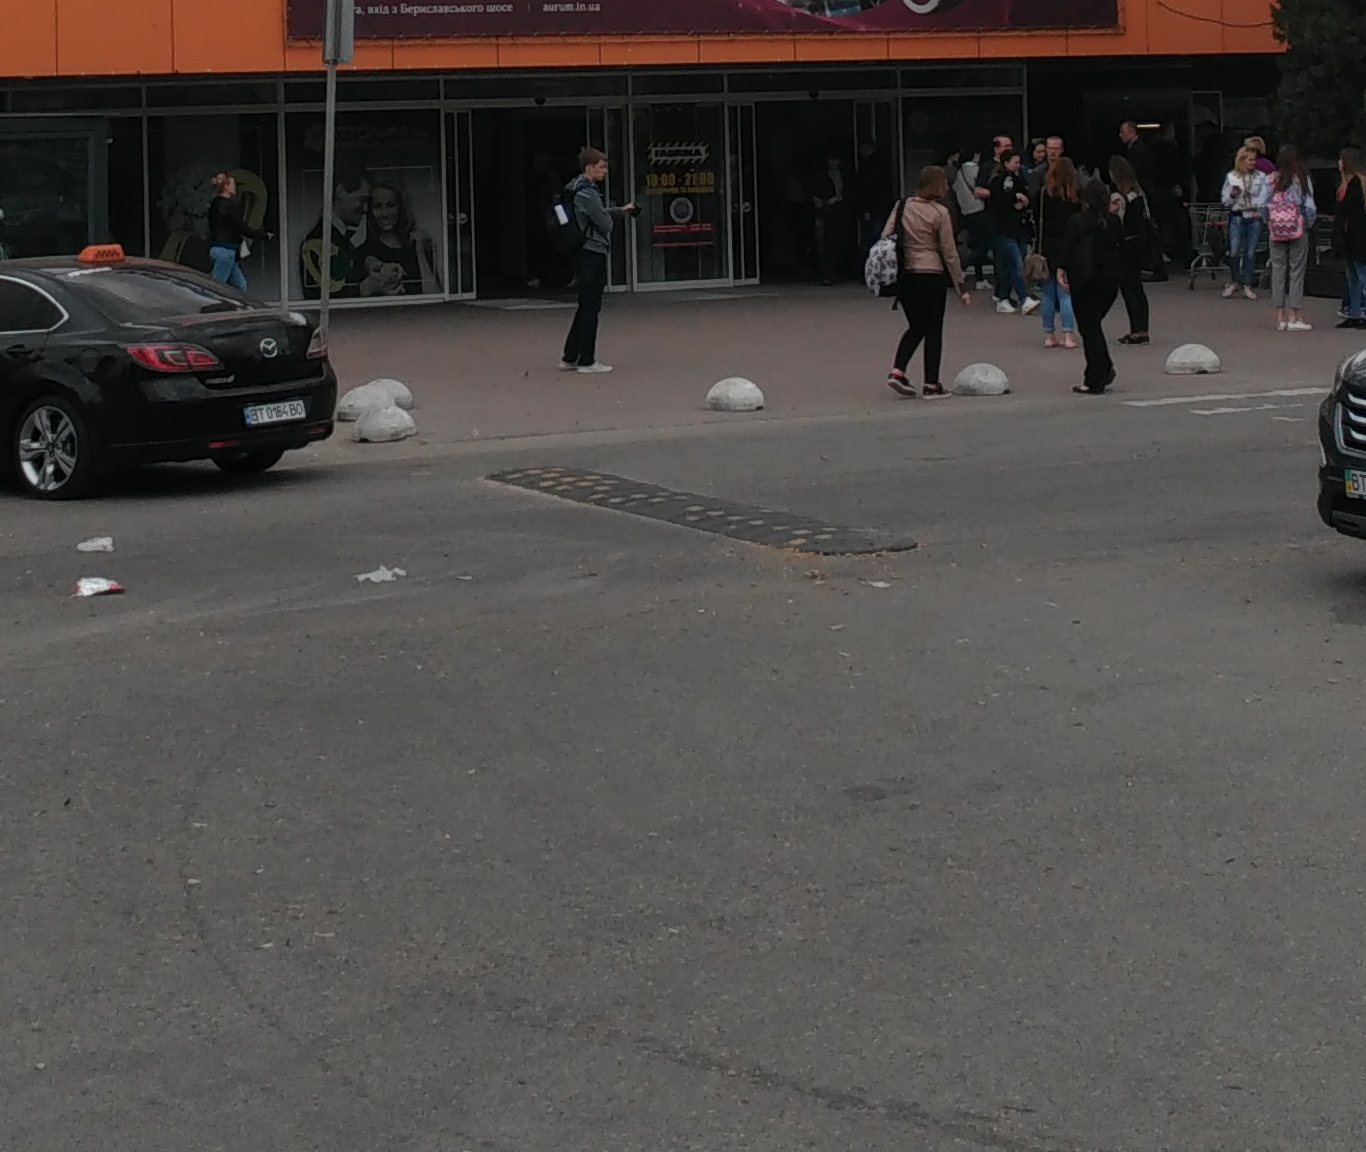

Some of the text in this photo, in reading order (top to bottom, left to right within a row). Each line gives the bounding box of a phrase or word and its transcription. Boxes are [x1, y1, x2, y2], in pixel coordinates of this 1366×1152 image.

[400, 2, 483, 17] Бериславського
[487, 4, 514, 14] шосе
[542, 2, 601, 13] aurum.in.ua
[1351, 473, 1366, 492] BT
